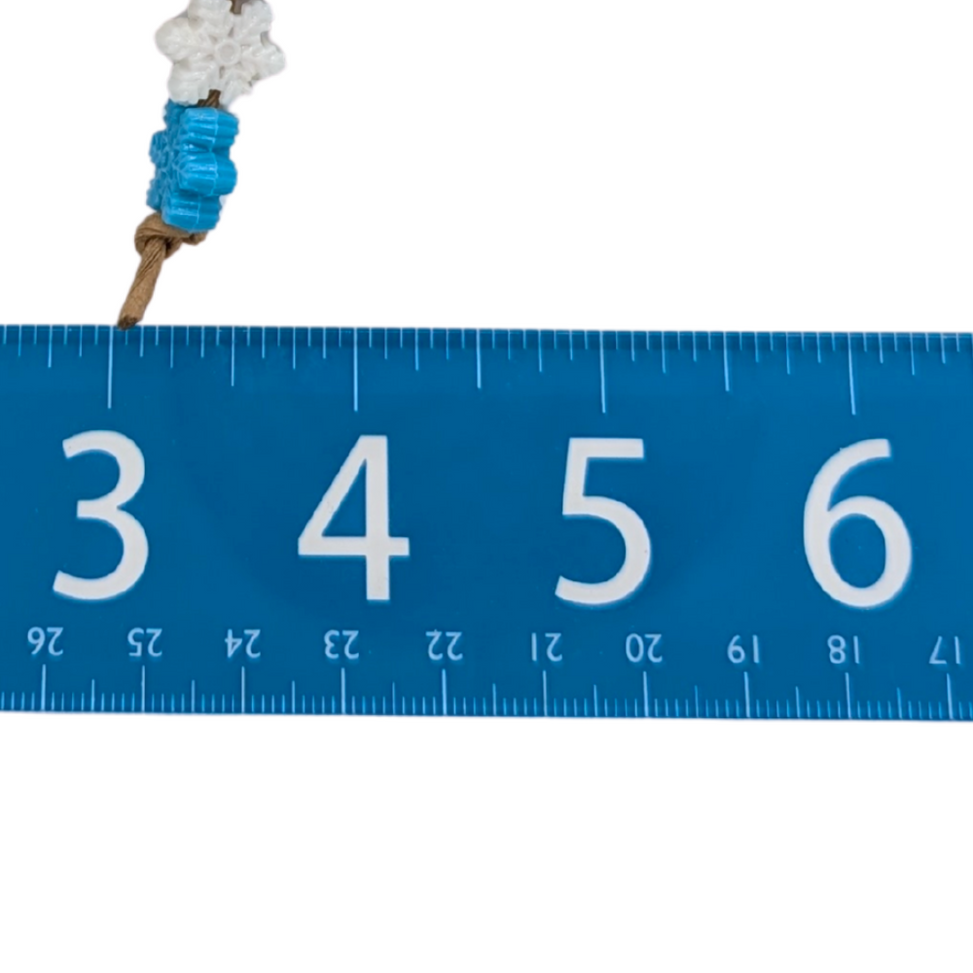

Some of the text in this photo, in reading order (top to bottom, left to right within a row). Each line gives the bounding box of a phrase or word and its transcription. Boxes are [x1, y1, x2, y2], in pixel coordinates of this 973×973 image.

[52, 430, 149, 601] 3
[298, 435, 410, 601] 4
[554, 437, 652, 606] 5
[803, 438, 913, 609] 6
[27, 627, 63, 656] 26
[128, 628, 162, 657] 25
[225, 629, 260, 658] 24
[324, 630, 359, 659] 23
[427, 631, 462, 661] 22
[532, 633, 562, 662] 21
[626, 633, 662, 663] 20
[728, 635, 759, 663] 19
[828, 635, 860, 663] 18
[929, 638, 960, 663] 17
